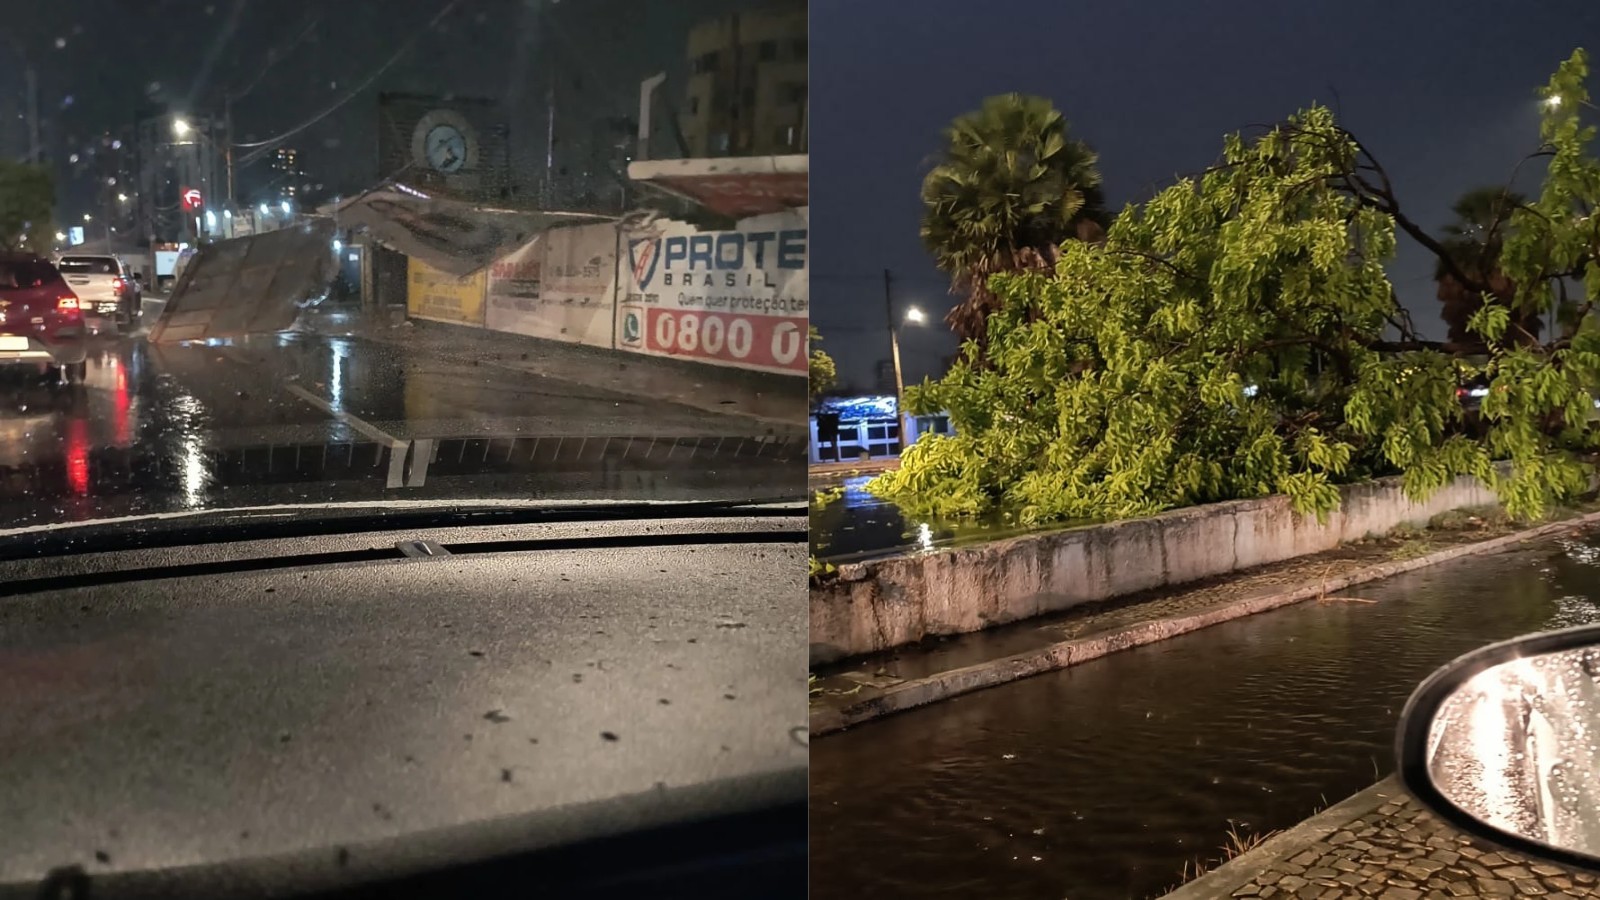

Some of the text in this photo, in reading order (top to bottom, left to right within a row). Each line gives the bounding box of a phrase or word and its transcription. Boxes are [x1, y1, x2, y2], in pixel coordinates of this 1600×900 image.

[666, 230, 807, 270] PROTE
[664, 272, 776, 288] BRASIL
[678, 292, 702, 306] Quem
[705, 296, 727, 308] quer
[730, 295, 786, 313] proteção
[656, 312, 753, 358] 0800
